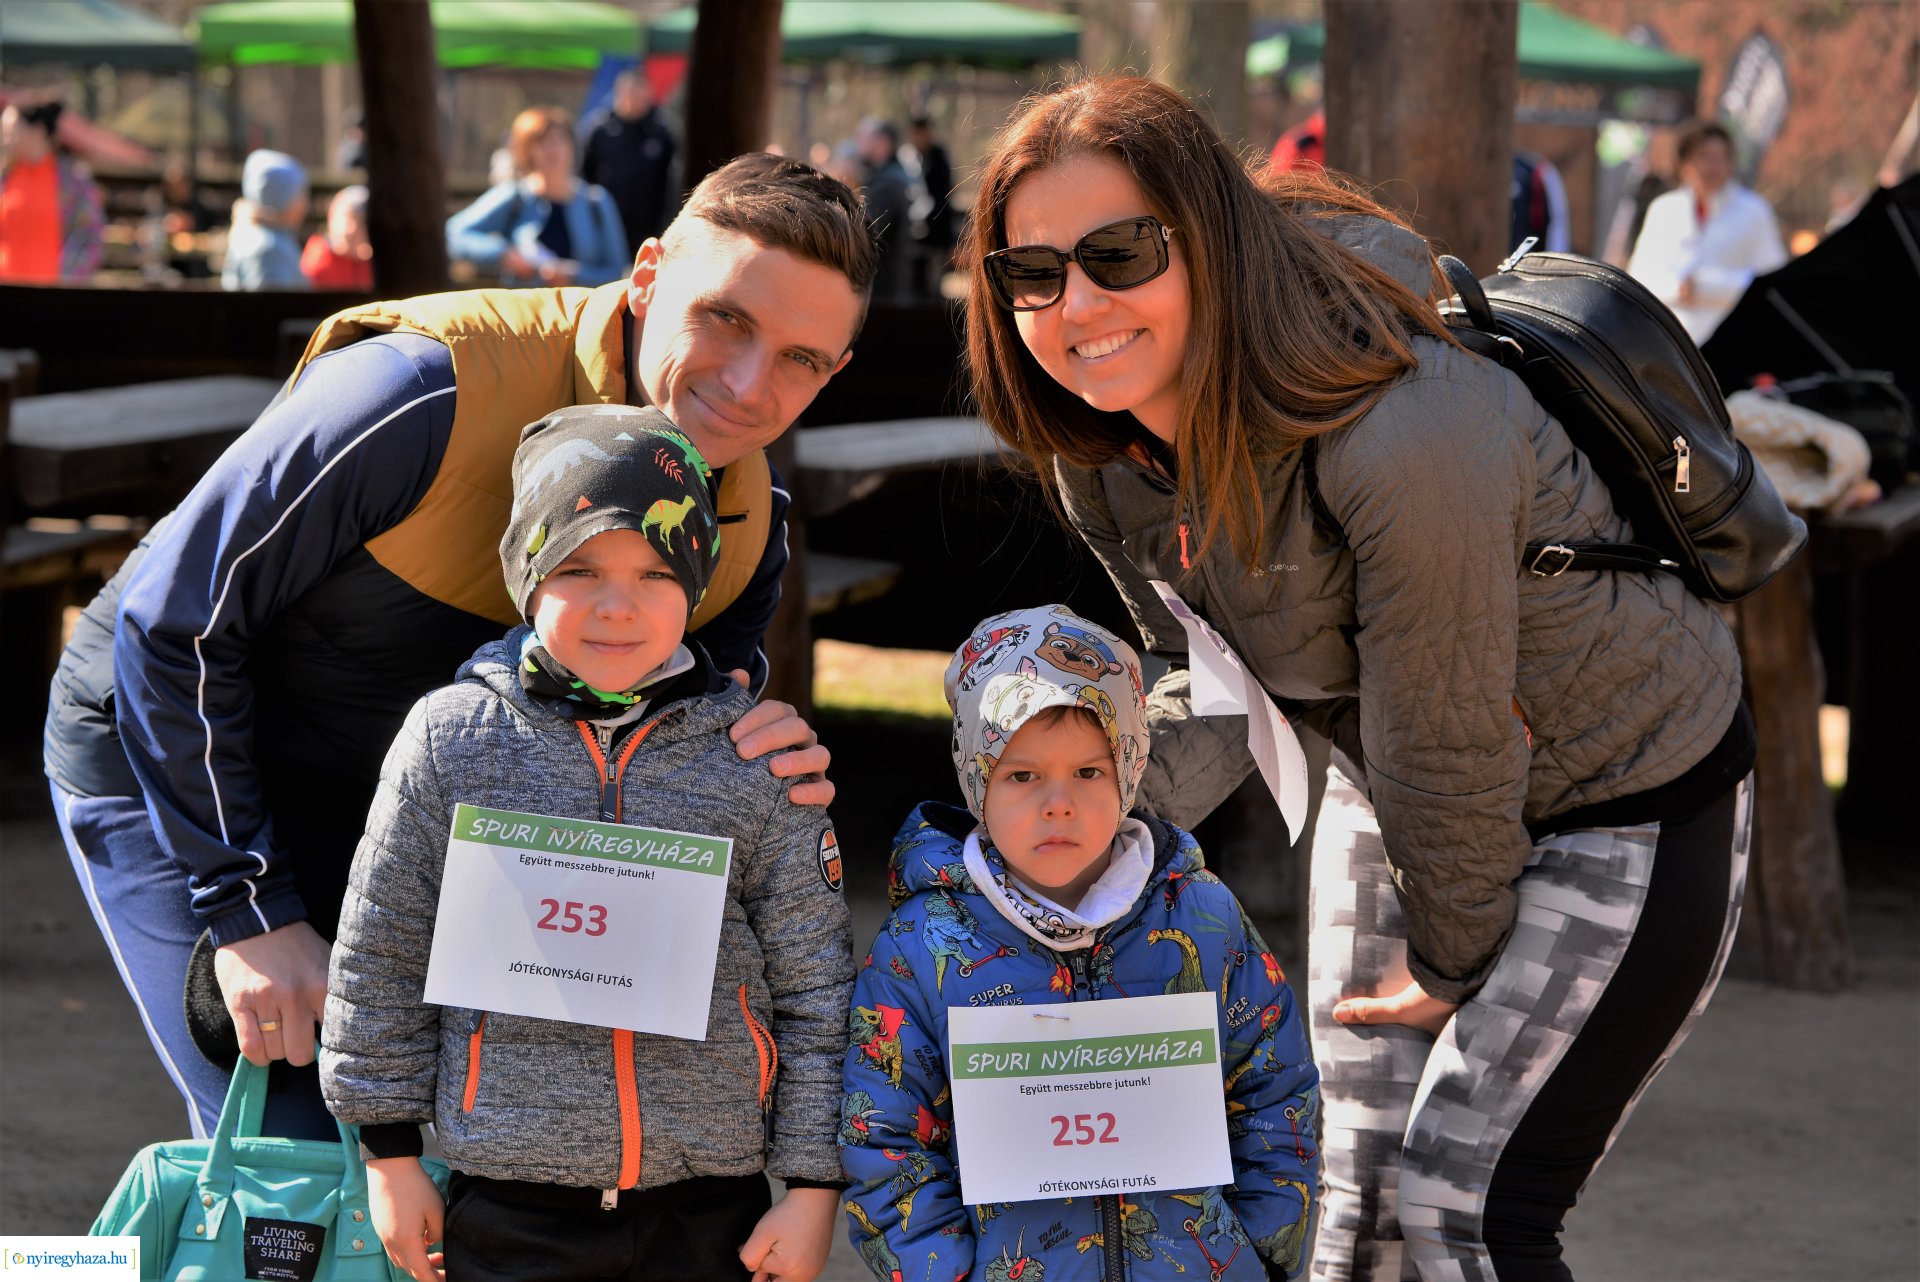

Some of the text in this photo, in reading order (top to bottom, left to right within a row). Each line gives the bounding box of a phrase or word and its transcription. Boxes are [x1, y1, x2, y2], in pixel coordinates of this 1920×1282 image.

[469, 817, 715, 868] SPURI NYÍREGYHÁZA
[518, 853, 655, 881] Együtt messzebbre jutunk!
[536, 898, 608, 937] 253
[508, 960, 633, 988] JÓTÉKONYSÁGI FUTÁS
[968, 983, 1014, 1007] SUPER
[1226, 996, 1248, 1023] PER
[1229, 1004, 1261, 1029] SAURUS
[966, 1037, 1203, 1073] SPURI NYÍREGYHÁZA
[1019, 1076, 1151, 1096] Együtt messzebbre jutunk!
[1050, 1112, 1120, 1147] 252
[1038, 1174, 1157, 1193] JÓTÉKONYSÁGI FUTÁS
[250, 1235, 315, 1253] TRAVELING
[263, 1227, 306, 1240] LIVING
[1038, 1220, 1063, 1244] TO THE
[260, 1247, 302, 1262] SHARE
